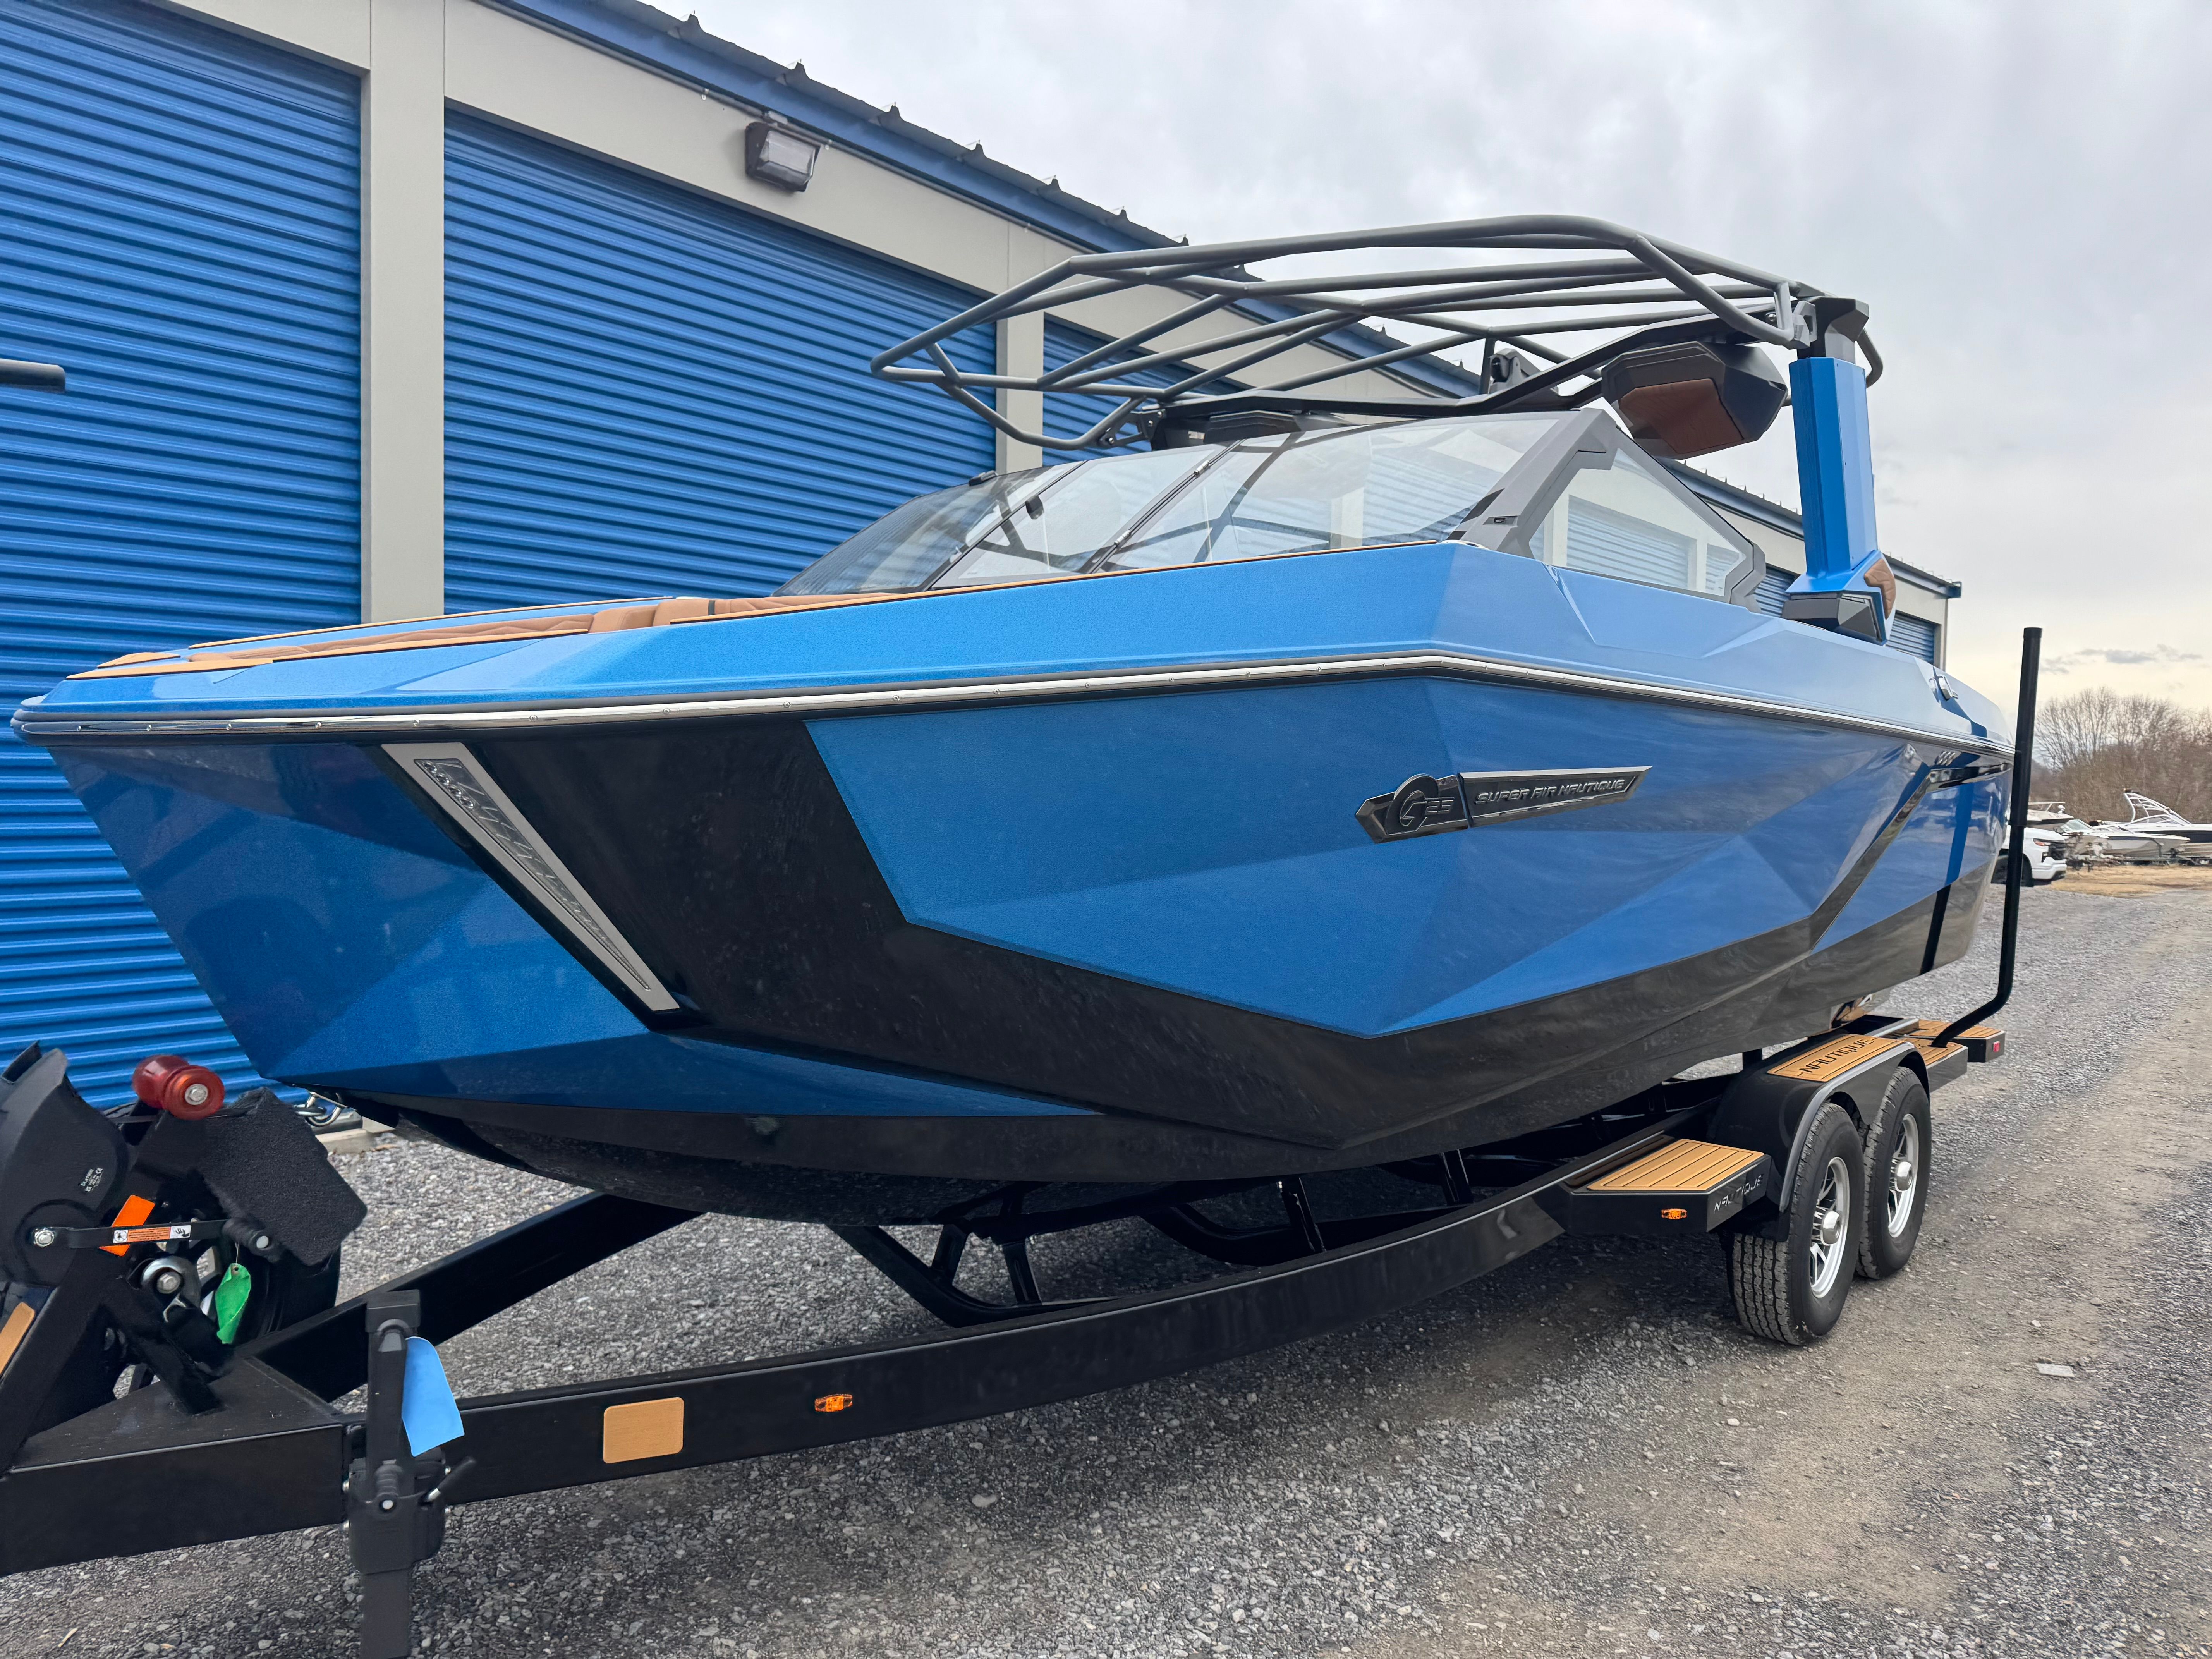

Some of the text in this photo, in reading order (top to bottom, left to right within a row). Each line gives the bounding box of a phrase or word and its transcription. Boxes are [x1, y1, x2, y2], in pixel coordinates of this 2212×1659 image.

[1475, 789, 1530, 803] SUPER
[1530, 786, 1557, 799] AIR
[1558, 779, 1625, 795] NAUTIQUE
[1799, 1039, 1874, 1072] NAUTIQUE
[1714, 1175, 1762, 1213] NAUTIQUE
